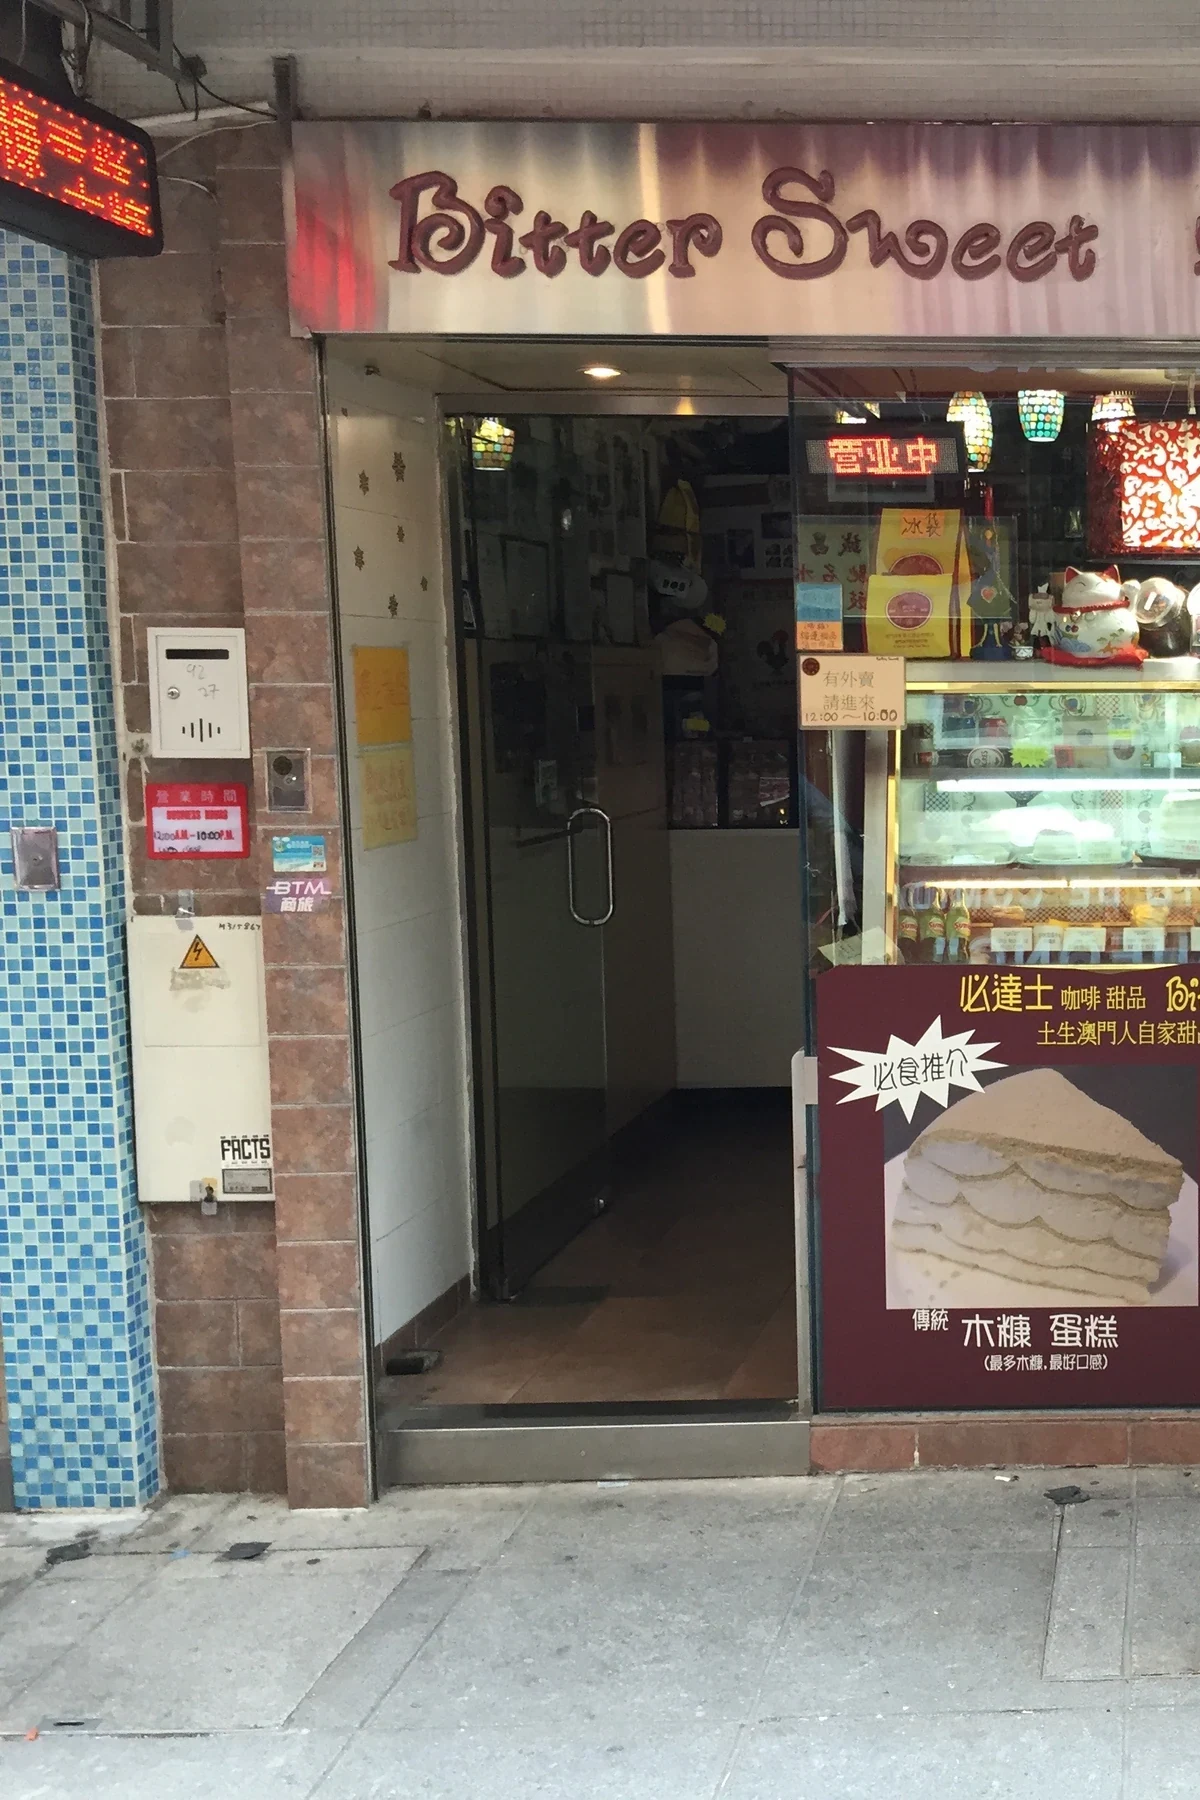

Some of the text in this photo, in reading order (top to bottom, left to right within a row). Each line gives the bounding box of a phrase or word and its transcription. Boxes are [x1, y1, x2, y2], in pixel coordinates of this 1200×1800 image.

[388, 166, 1099, 282] Bitter Sweet
[827, 436, 939, 475] 营业中
[823, 670, 875, 689] 有外賣
[823, 694, 875, 712] 請進來
[266, 881, 332, 895] BTM
[959, 973, 1147, 1013] 必達士 咖啡 甜品
[872, 1048, 970, 1090] 必食推介
[220, 1137, 271, 1161] FACTS
[912, 1308, 1119, 1348] 傳統 木糠 蛋糕
